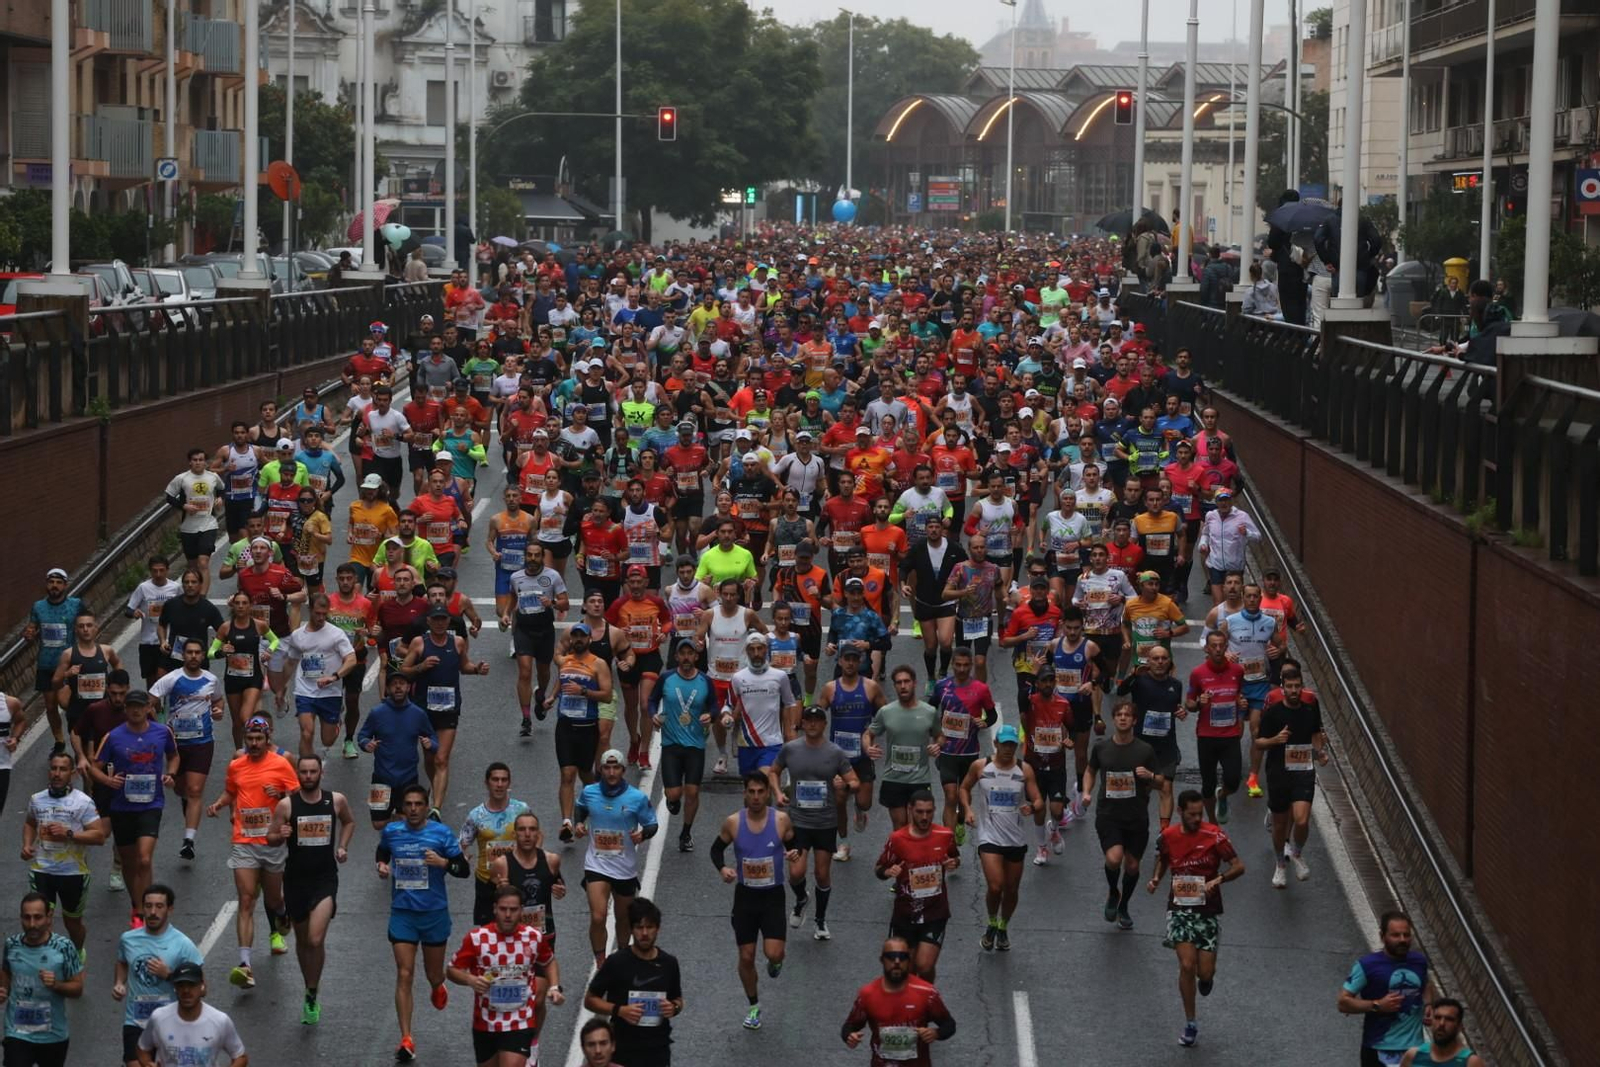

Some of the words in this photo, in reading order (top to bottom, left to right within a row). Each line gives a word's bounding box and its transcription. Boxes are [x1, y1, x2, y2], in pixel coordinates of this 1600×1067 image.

[909, 194, 917, 205] P
[330, 615, 359, 625] KENYA
[81, 681, 101, 690] 4435
[301, 823, 325, 833] 4372
[914, 873, 936, 886] 3545
[496, 985, 520, 999] 1713
